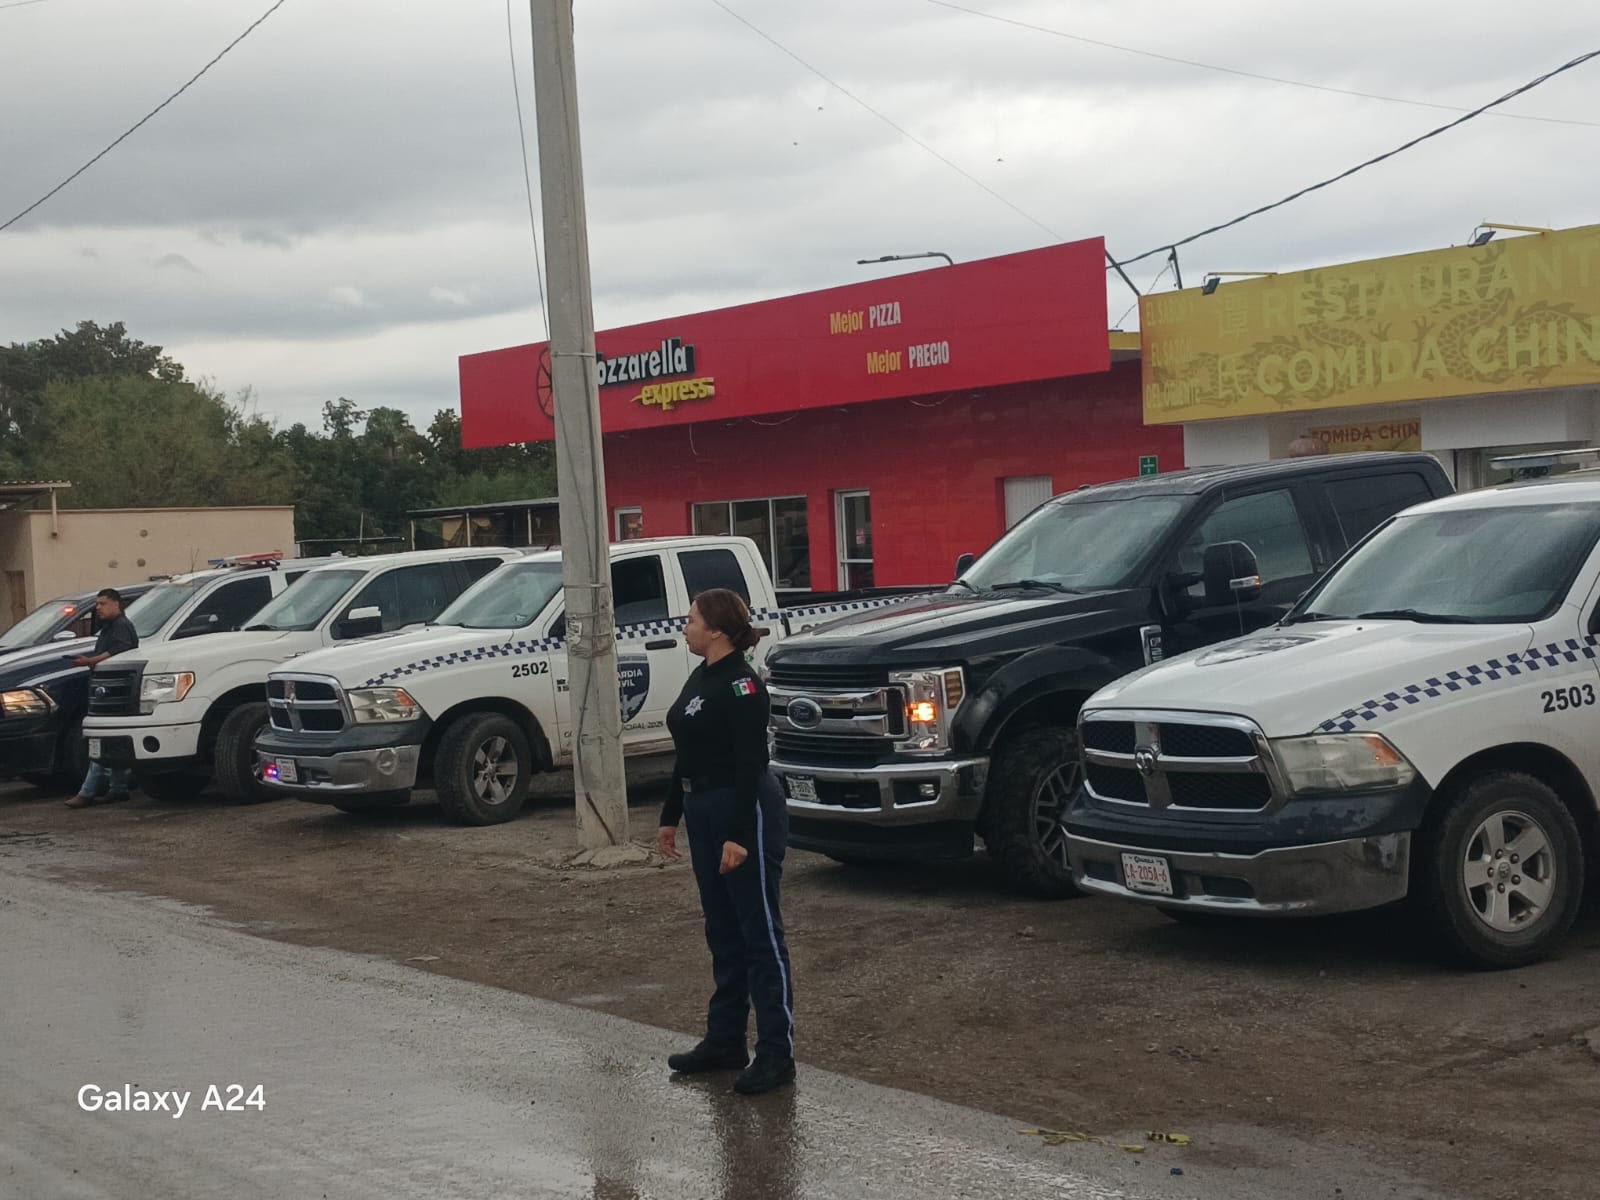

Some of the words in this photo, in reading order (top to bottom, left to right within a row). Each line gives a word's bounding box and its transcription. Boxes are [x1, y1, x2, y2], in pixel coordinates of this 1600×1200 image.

[1262, 239, 1600, 329] RESTAURANT
[830, 310, 864, 334] Mejor
[869, 301, 902, 328] PIZZA
[596, 338, 688, 386] ozzarella
[866, 349, 902, 374] Mejor
[908, 341, 950, 369] PRECIO
[1256, 339, 1449, 395] COMIDA
[1469, 315, 1600, 374] CHIN
[636, 377, 715, 411] express
[1378, 421, 1419, 440] CHIN
[511, 660, 549, 678] 2502
[617, 668, 643, 679] ARDIA
[619, 679, 636, 687] VIL
[1540, 683, 1596, 714] 2503
